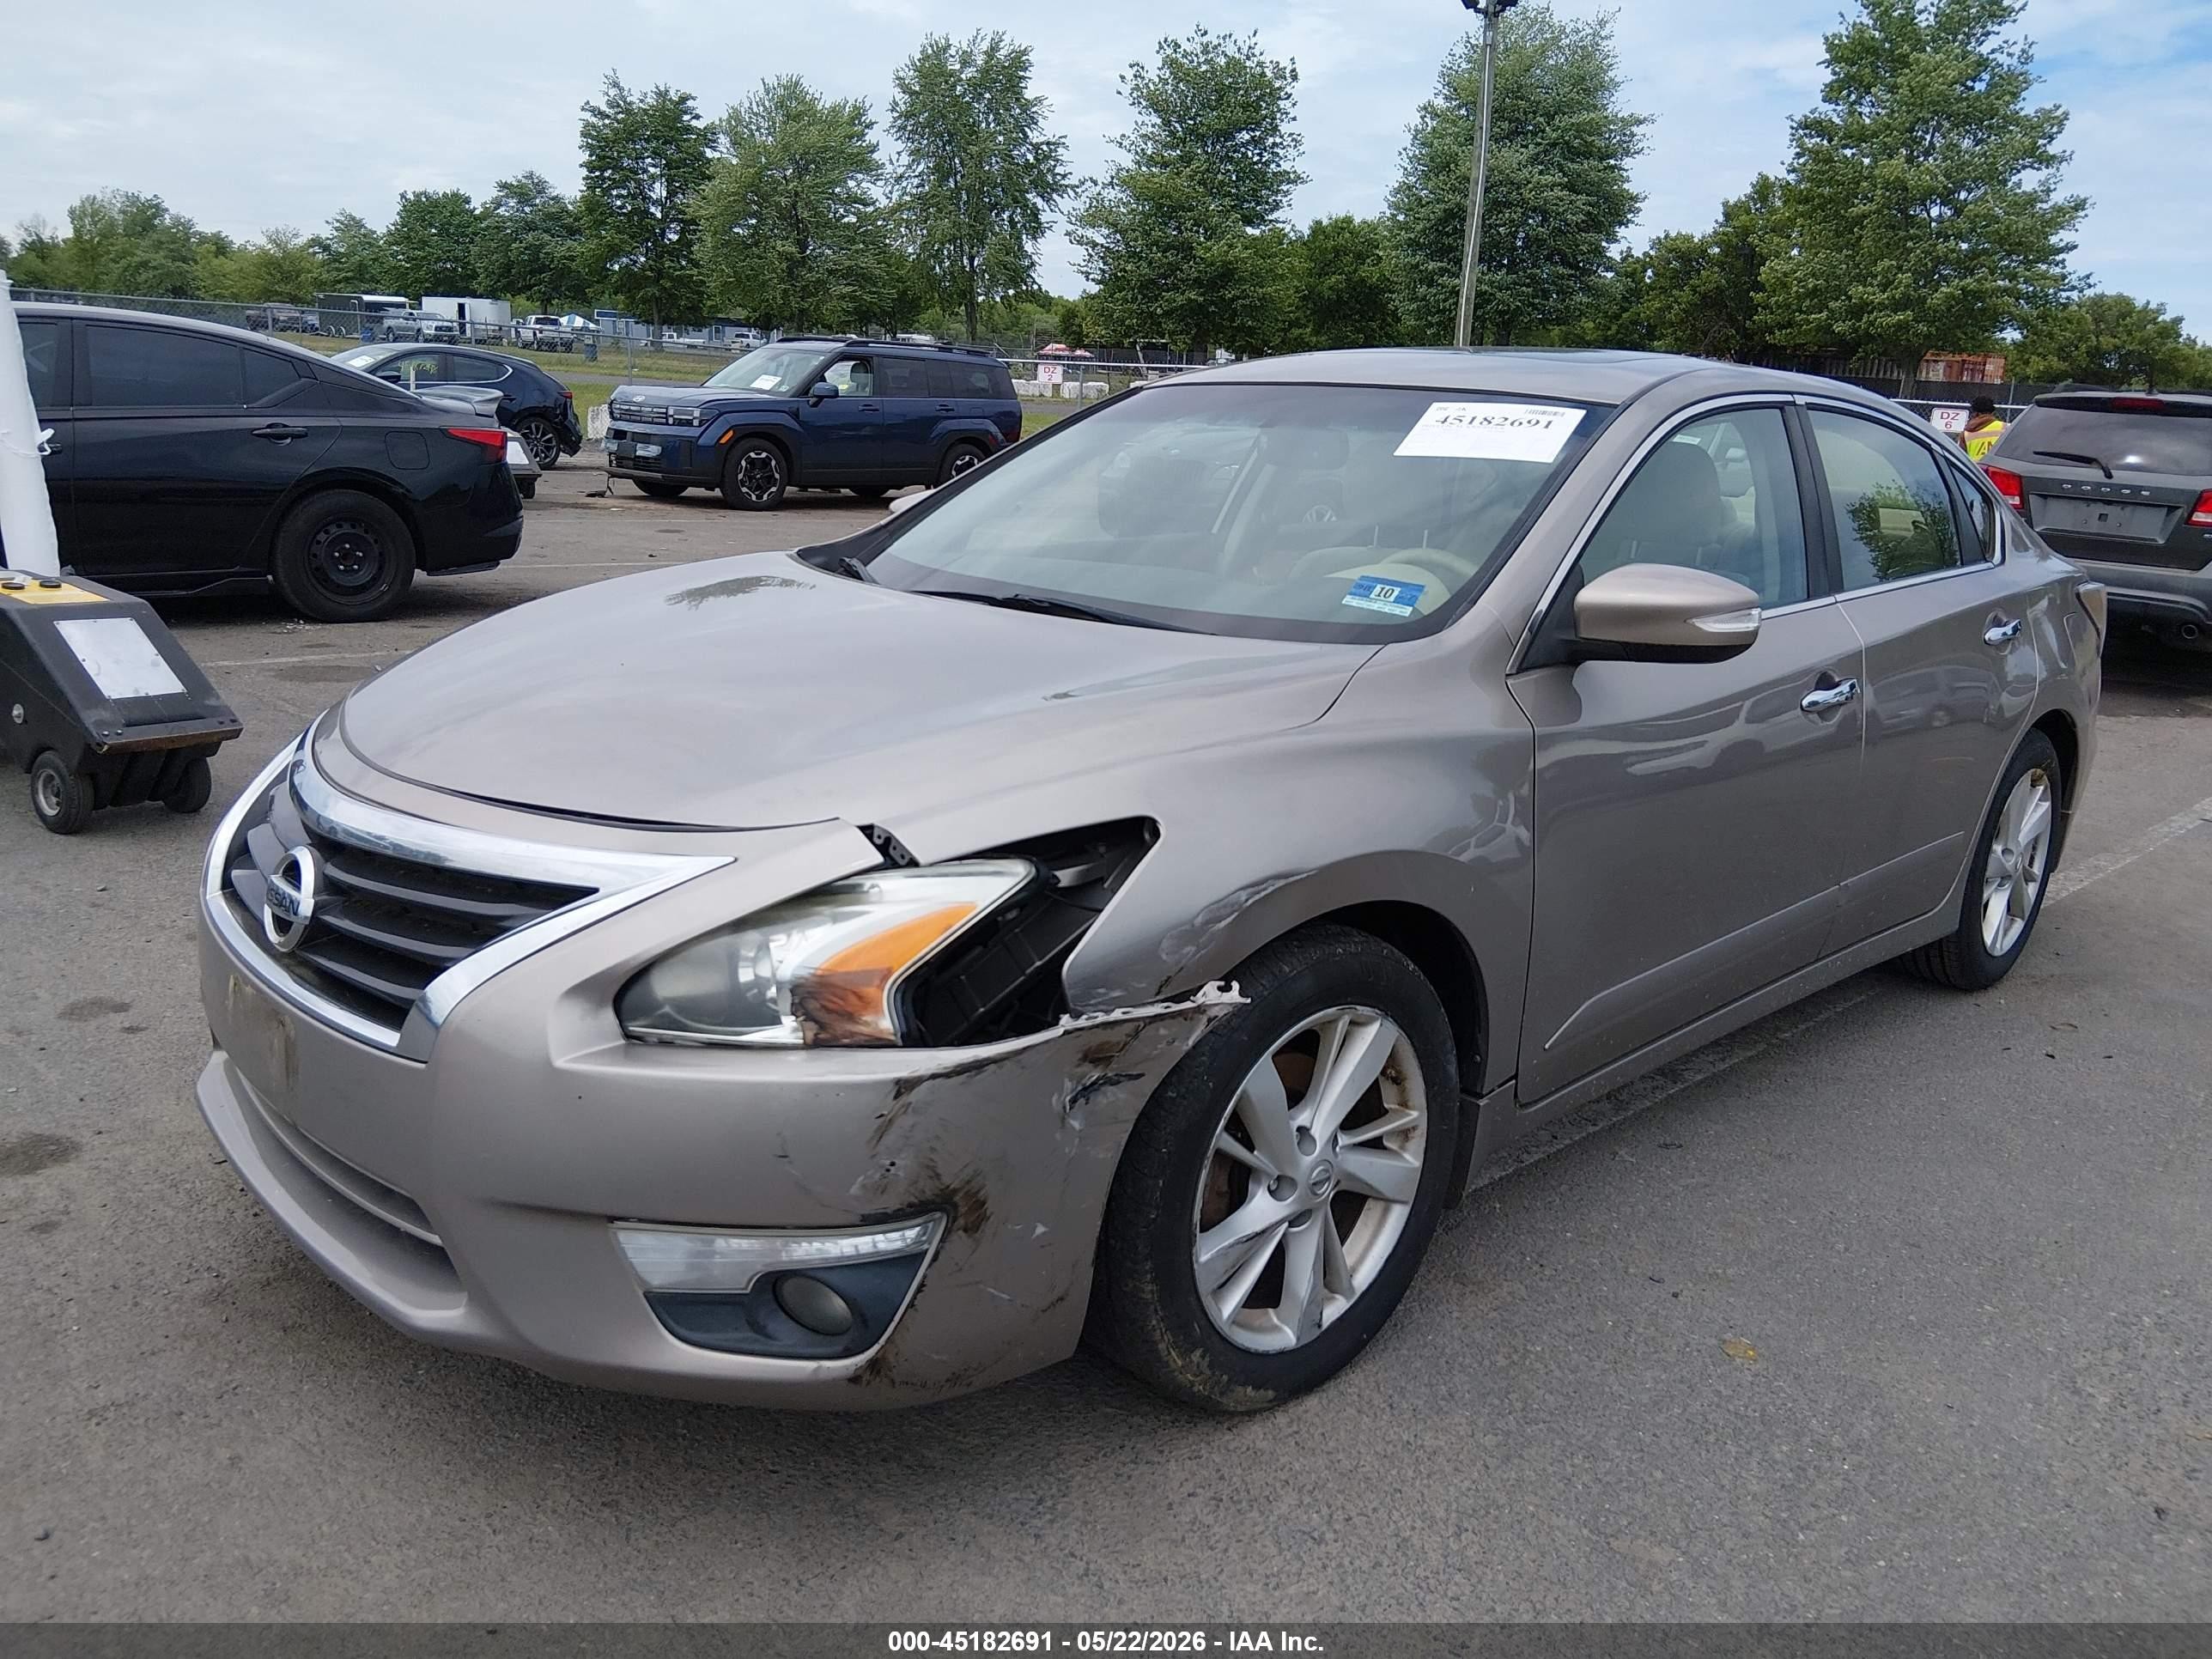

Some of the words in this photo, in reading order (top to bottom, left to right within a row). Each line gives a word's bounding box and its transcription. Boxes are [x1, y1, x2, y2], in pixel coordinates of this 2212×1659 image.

[1436, 415, 1553, 429] 45182691
[1944, 421, 1953, 429] 6
[1374, 586, 1395, 599] 10
